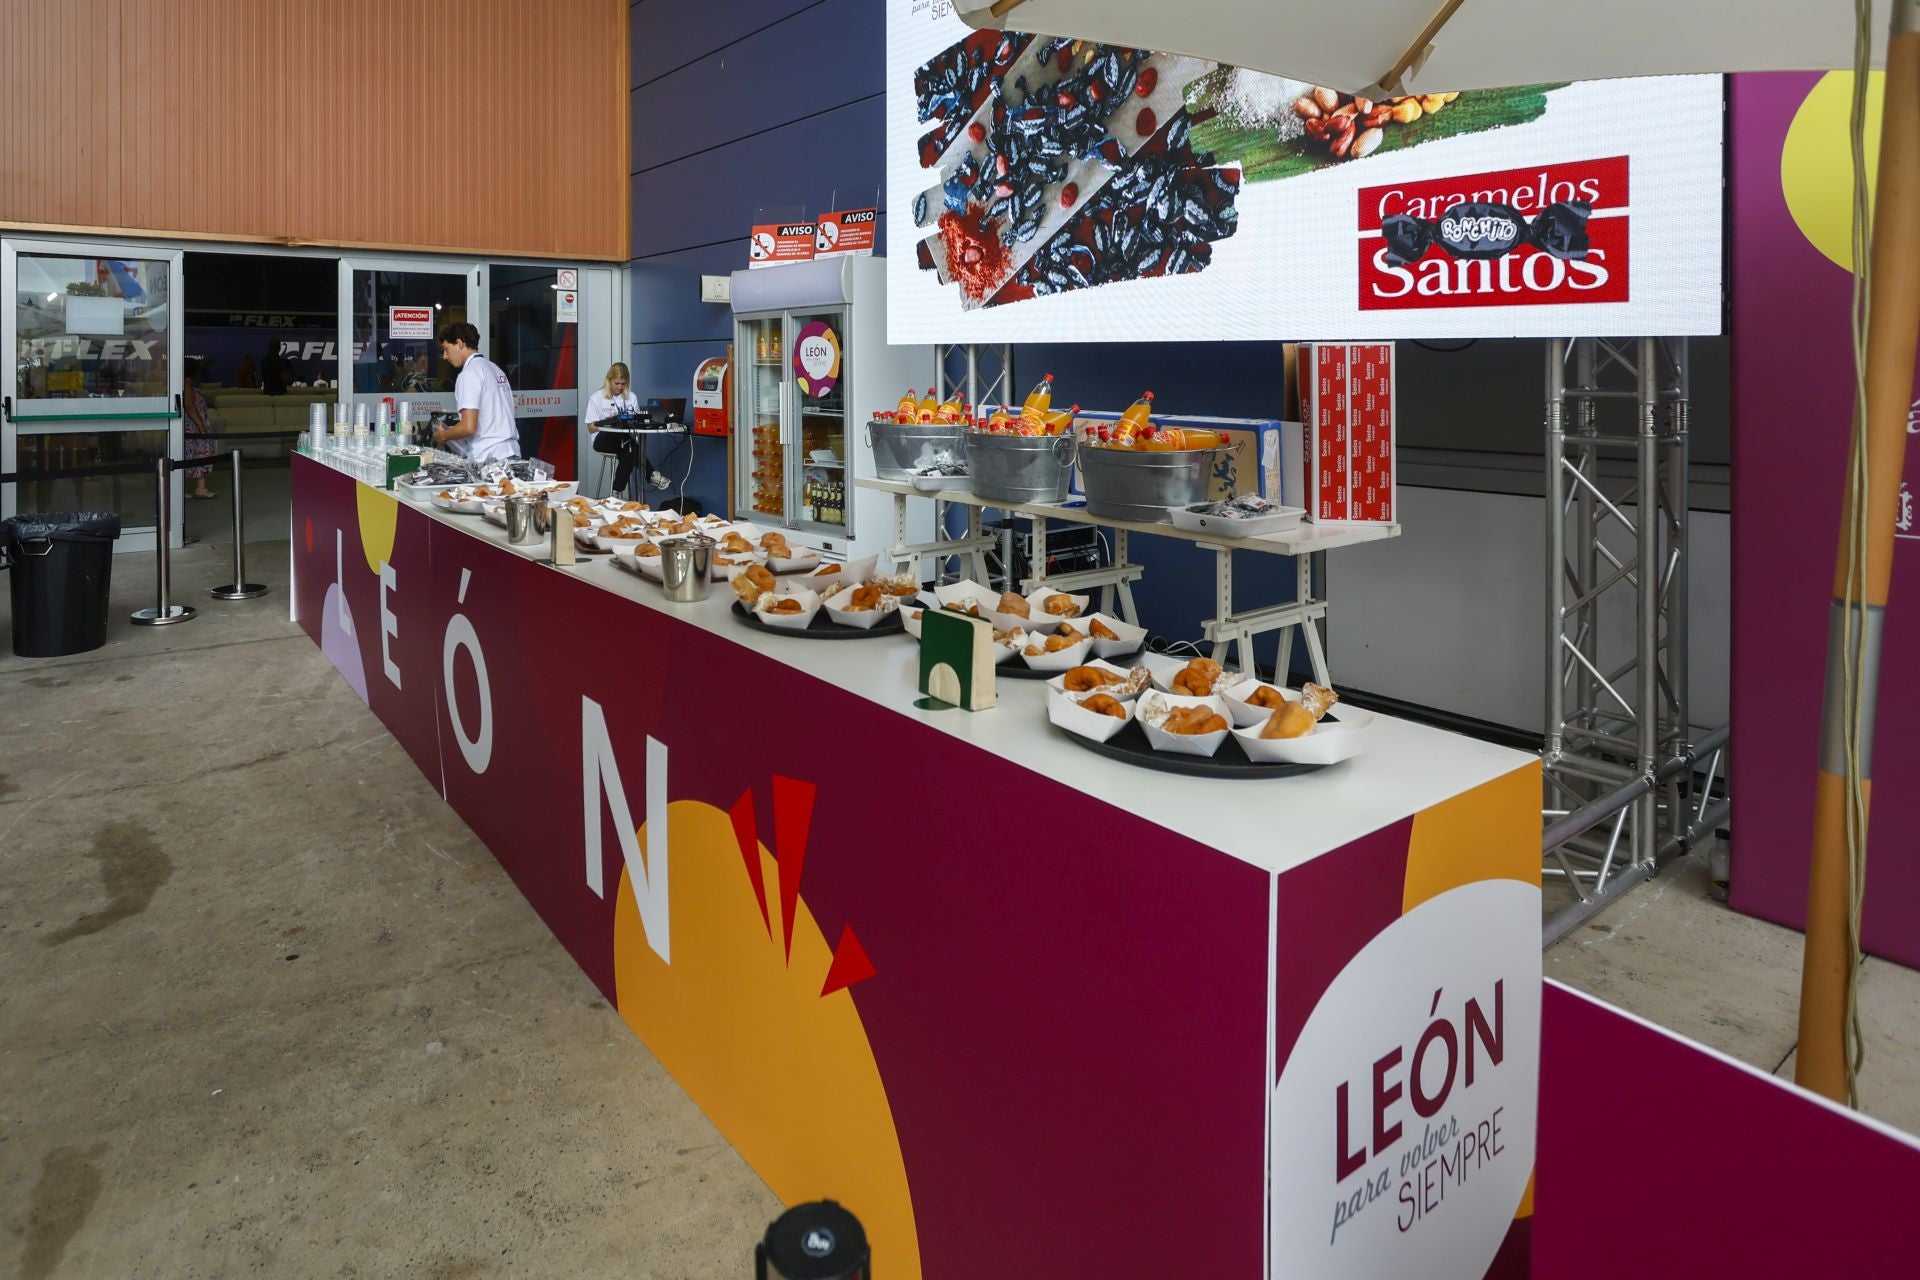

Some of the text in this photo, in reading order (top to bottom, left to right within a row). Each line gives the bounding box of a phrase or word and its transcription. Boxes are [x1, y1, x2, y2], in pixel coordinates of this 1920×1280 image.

[781, 226, 813, 236] AVISO
[845, 211, 874, 224] AVISO
[1372, 247, 1610, 298] Santos
[244, 315, 298, 328] FLEX
[394, 312, 428, 320] ¡ATENCIÓN!
[806, 344, 827, 357] LEÓN
[336, 528, 671, 966] LEÓN
[1336, 978, 1504, 1184] LEÓN
[1330, 1115, 1460, 1245] para volver
[1397, 1106, 1505, 1233] SIEMPRE
